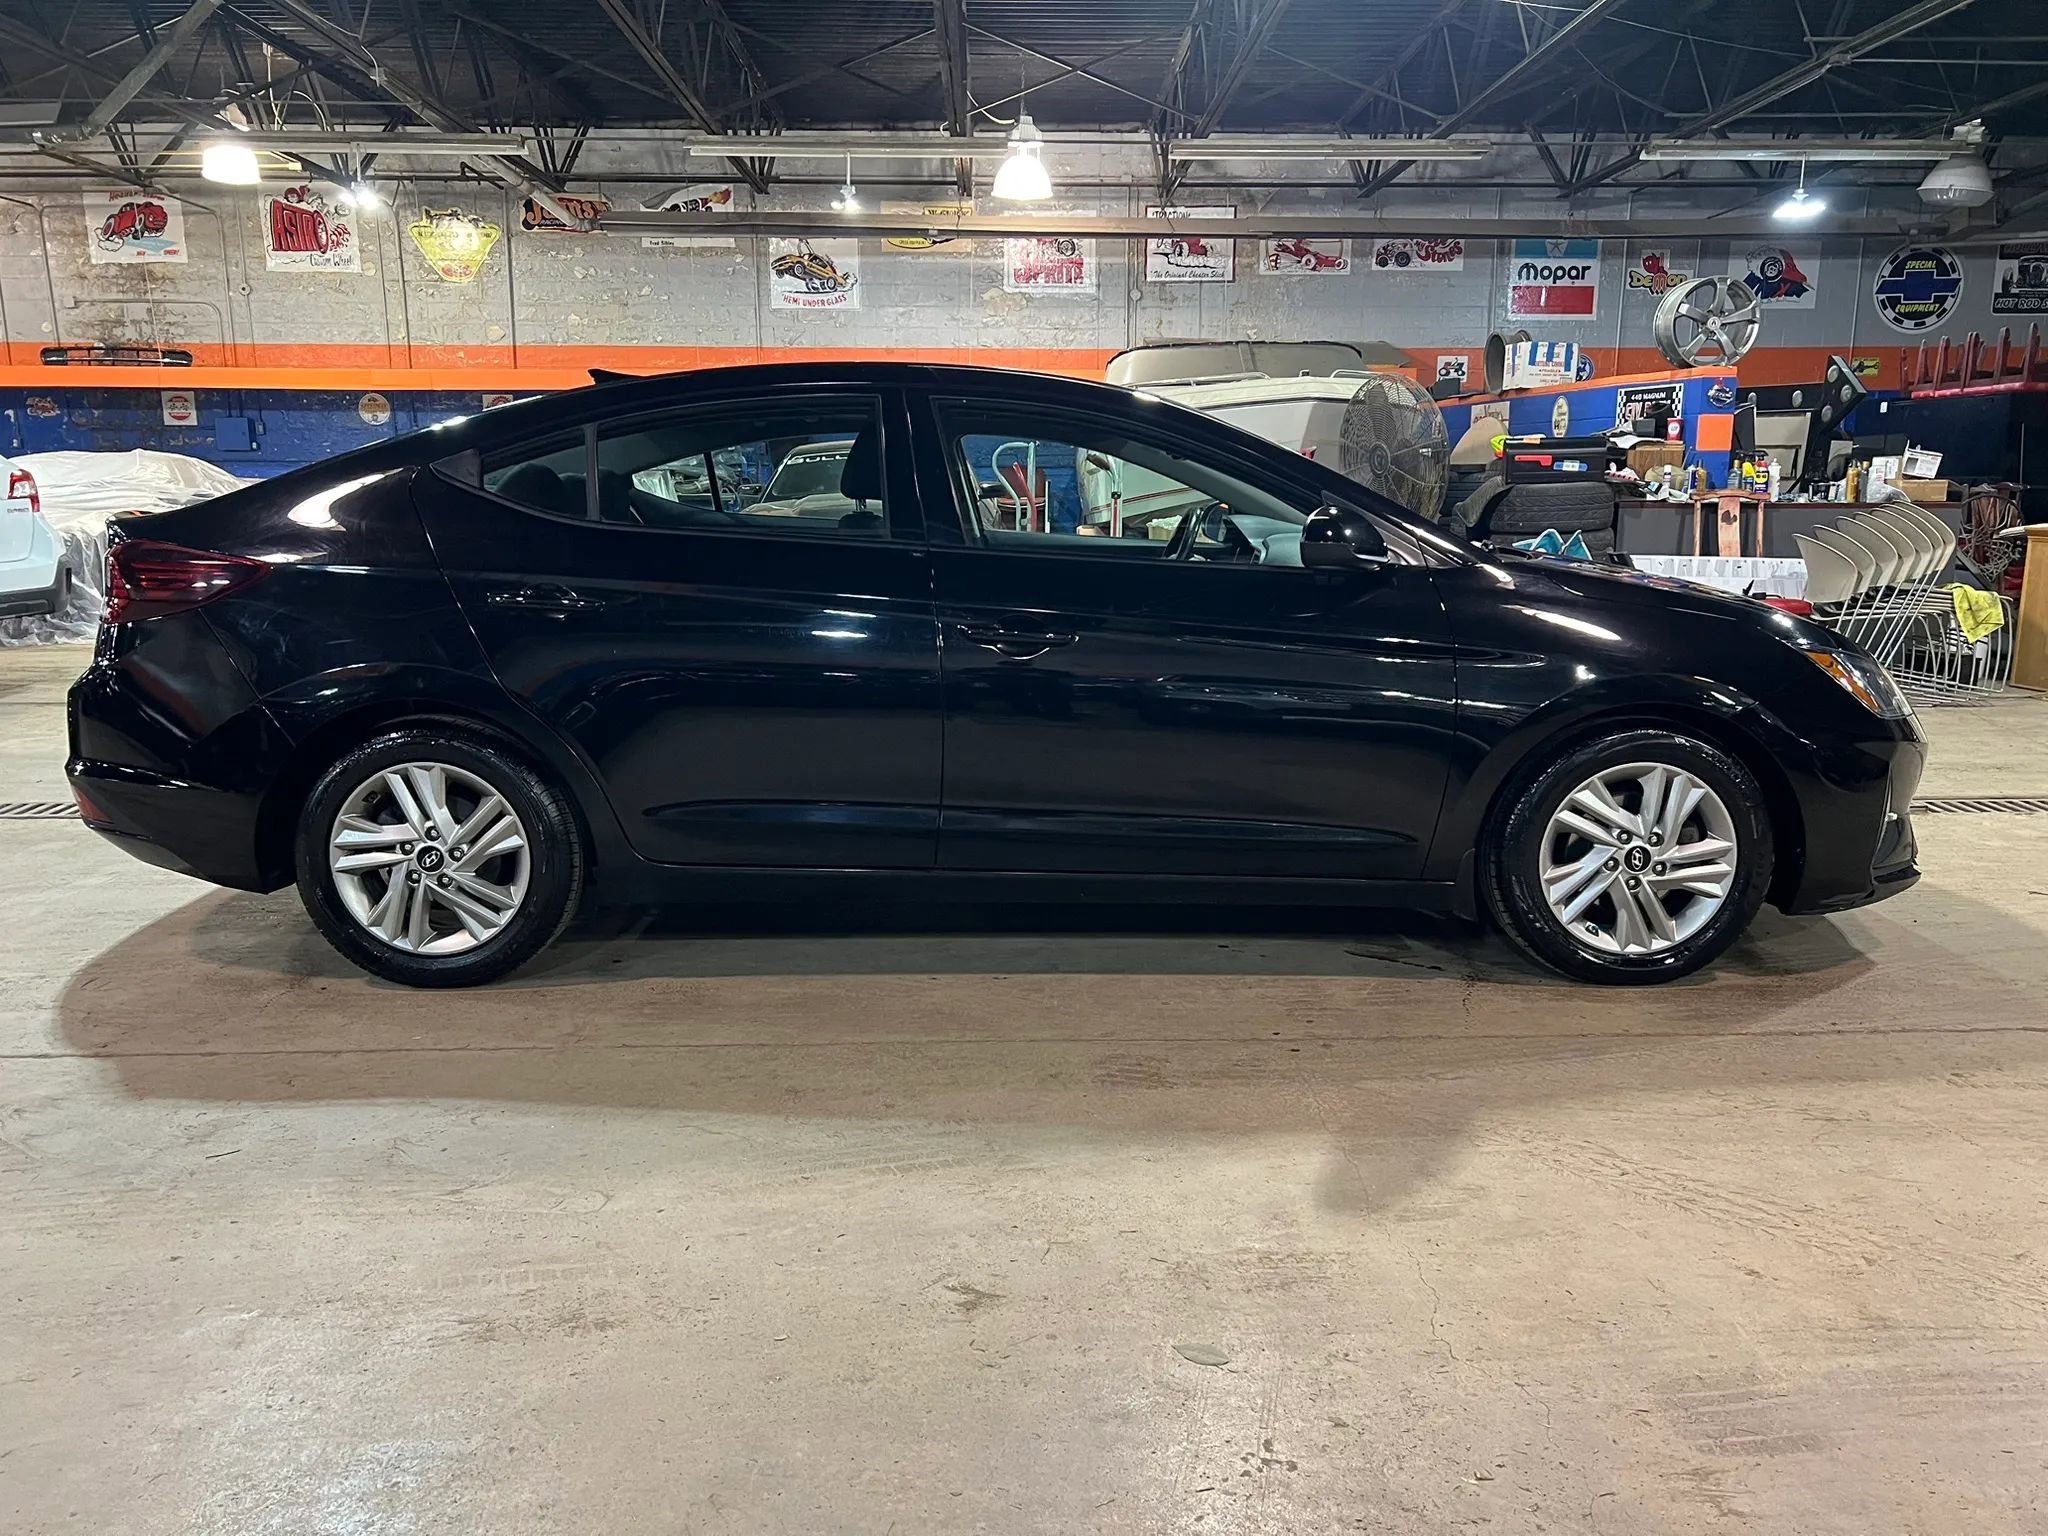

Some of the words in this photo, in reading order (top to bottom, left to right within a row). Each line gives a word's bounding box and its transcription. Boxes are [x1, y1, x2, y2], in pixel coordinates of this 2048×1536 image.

[271, 199, 329, 254] ASTRO
[1905, 260, 1937, 269] SPECIAL
[1517, 262, 1592, 284] Mopar
[802, 297, 826, 307] UNDER
[1994, 297, 2018, 309] HOT
[2017, 297, 2041, 309] ROD
[1895, 303, 1941, 314] EQUIPMENT
